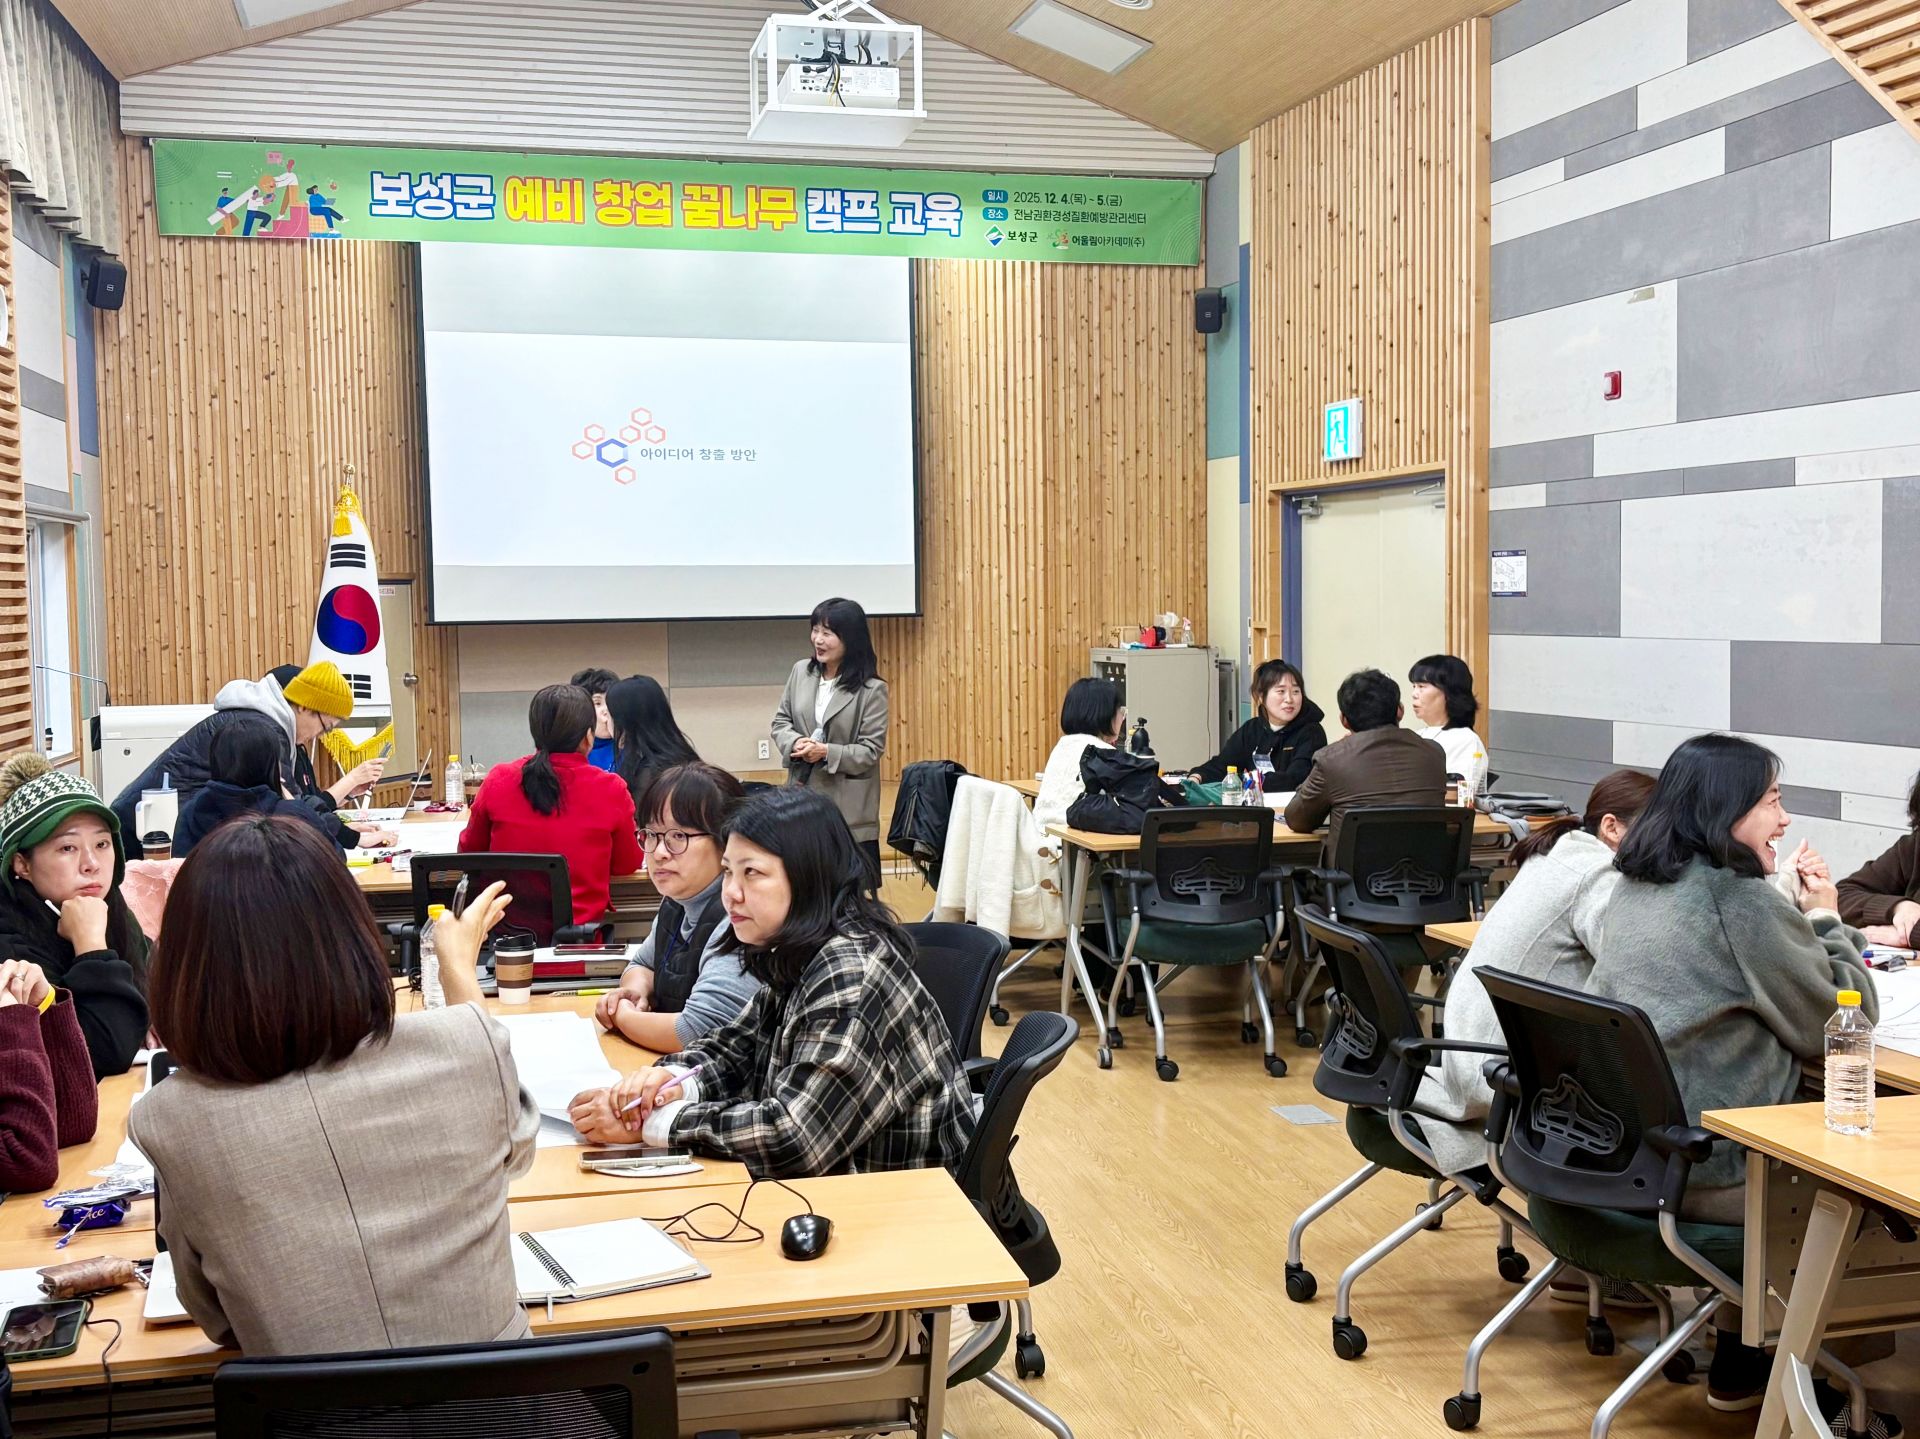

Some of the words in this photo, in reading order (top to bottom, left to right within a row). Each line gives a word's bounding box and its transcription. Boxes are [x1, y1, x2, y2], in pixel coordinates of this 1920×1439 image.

[987, 191, 1004, 202] 일시
[1014, 192, 1042, 204] 2025.
[1045, 193, 1059, 204] 12.
[370, 171, 495, 221] 보성군
[504, 176, 586, 225] 예비
[593, 178, 674, 228] 창업
[681, 183, 798, 232] 꿈나무
[805, 188, 881, 233] 캠프
[887, 192, 963, 237] 교육
[987, 208, 1004, 219] 장소
[1014, 209, 1147, 225] 전남권환경성질환예방관리센터
[1008, 231, 1039, 243] 보성군
[1072, 235, 1145, 248] 어울림아카데미(주)
[640, 448, 694, 461] 아이디어
[699, 448, 725, 461] 창출
[730, 448, 757, 462] 방안
